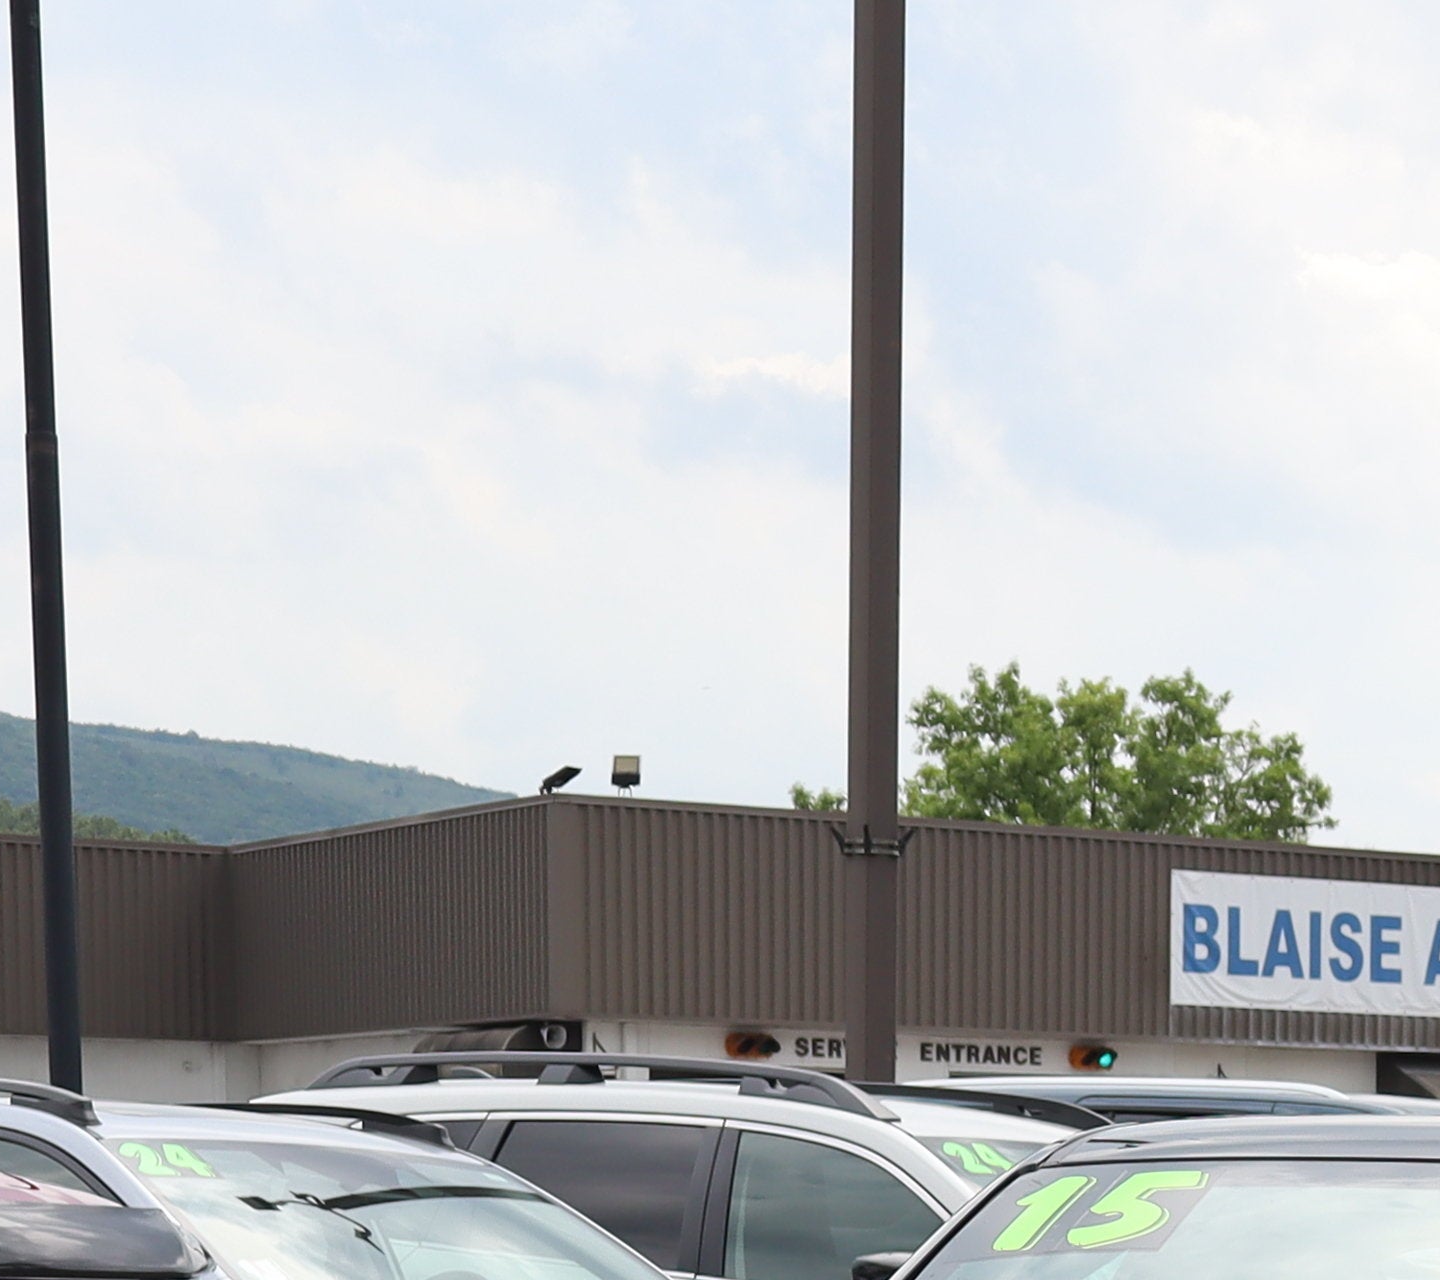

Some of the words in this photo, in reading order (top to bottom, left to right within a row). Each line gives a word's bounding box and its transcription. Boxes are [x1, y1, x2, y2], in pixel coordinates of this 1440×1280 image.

[1181, 902, 1404, 985] BLAISE
[794, 1037, 847, 1059] SER
[920, 1043, 1043, 1066] ENTRANCE
[118, 1141, 217, 1178] 24
[991, 1170, 1209, 1252] 15
